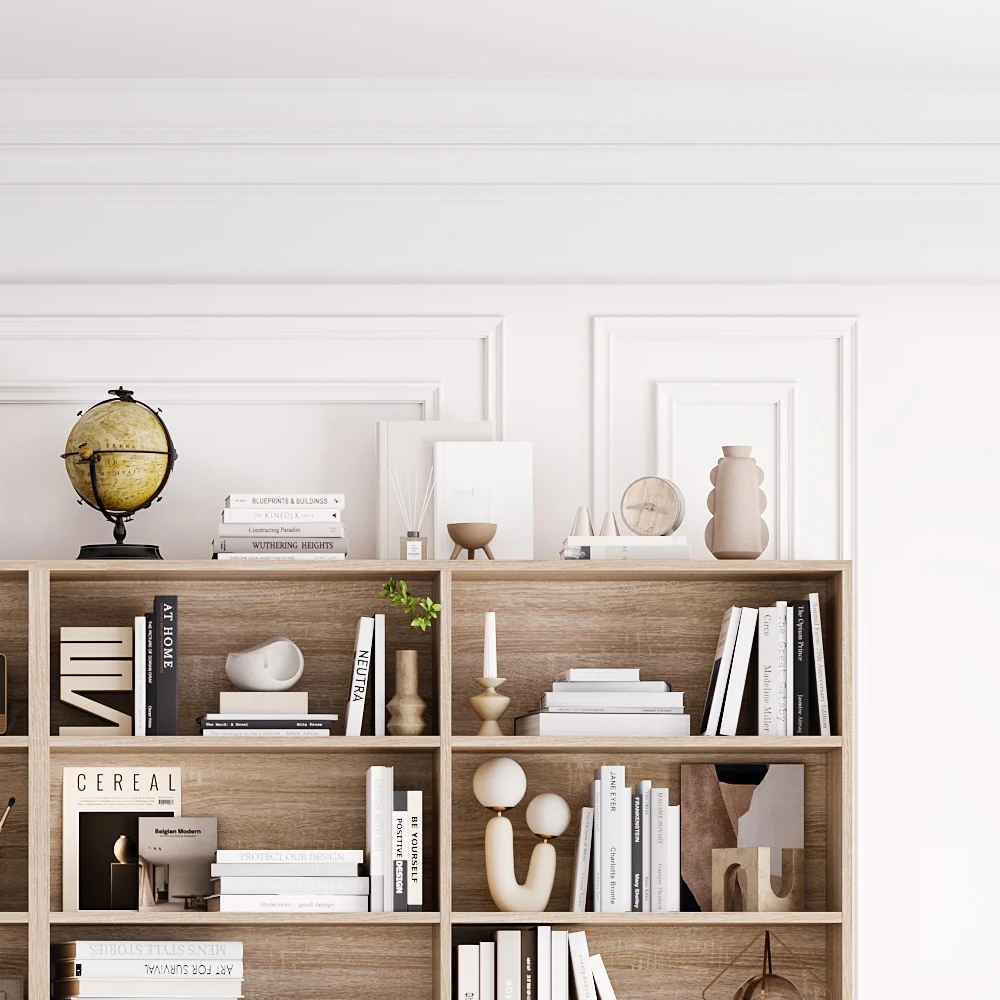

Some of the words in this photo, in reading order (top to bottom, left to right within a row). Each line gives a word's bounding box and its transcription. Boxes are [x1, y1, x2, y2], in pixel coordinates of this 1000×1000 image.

[252, 541, 298, 549] WUTHERING
[301, 541, 334, 549] HEIGHTS
[163, 603, 173, 621] AT
[763, 614, 772, 637] Circe
[163, 627, 173, 668] HOME
[352, 649, 370, 702] NEUTRA
[763, 665, 772, 704] Madeline
[763, 706, 772, 732] Miller
[77, 773, 176, 792] CEREAL
[411, 816, 418, 829] BE
[155, 828, 177, 836] Belgian
[240, 852, 283, 861] PROTECT
[288, 852, 307, 861] OUR
[309, 852, 344, 861] DESIGN
[395, 861, 403, 894] DESIGN
[89, 944, 143, 956] STORIES
[145, 944, 185, 956] STYLE
[188, 944, 227, 956] MEN'S
[145, 964, 189, 975] SURVIVAL
[192, 964, 212, 975] FOR
[215, 964, 234, 975] ART
